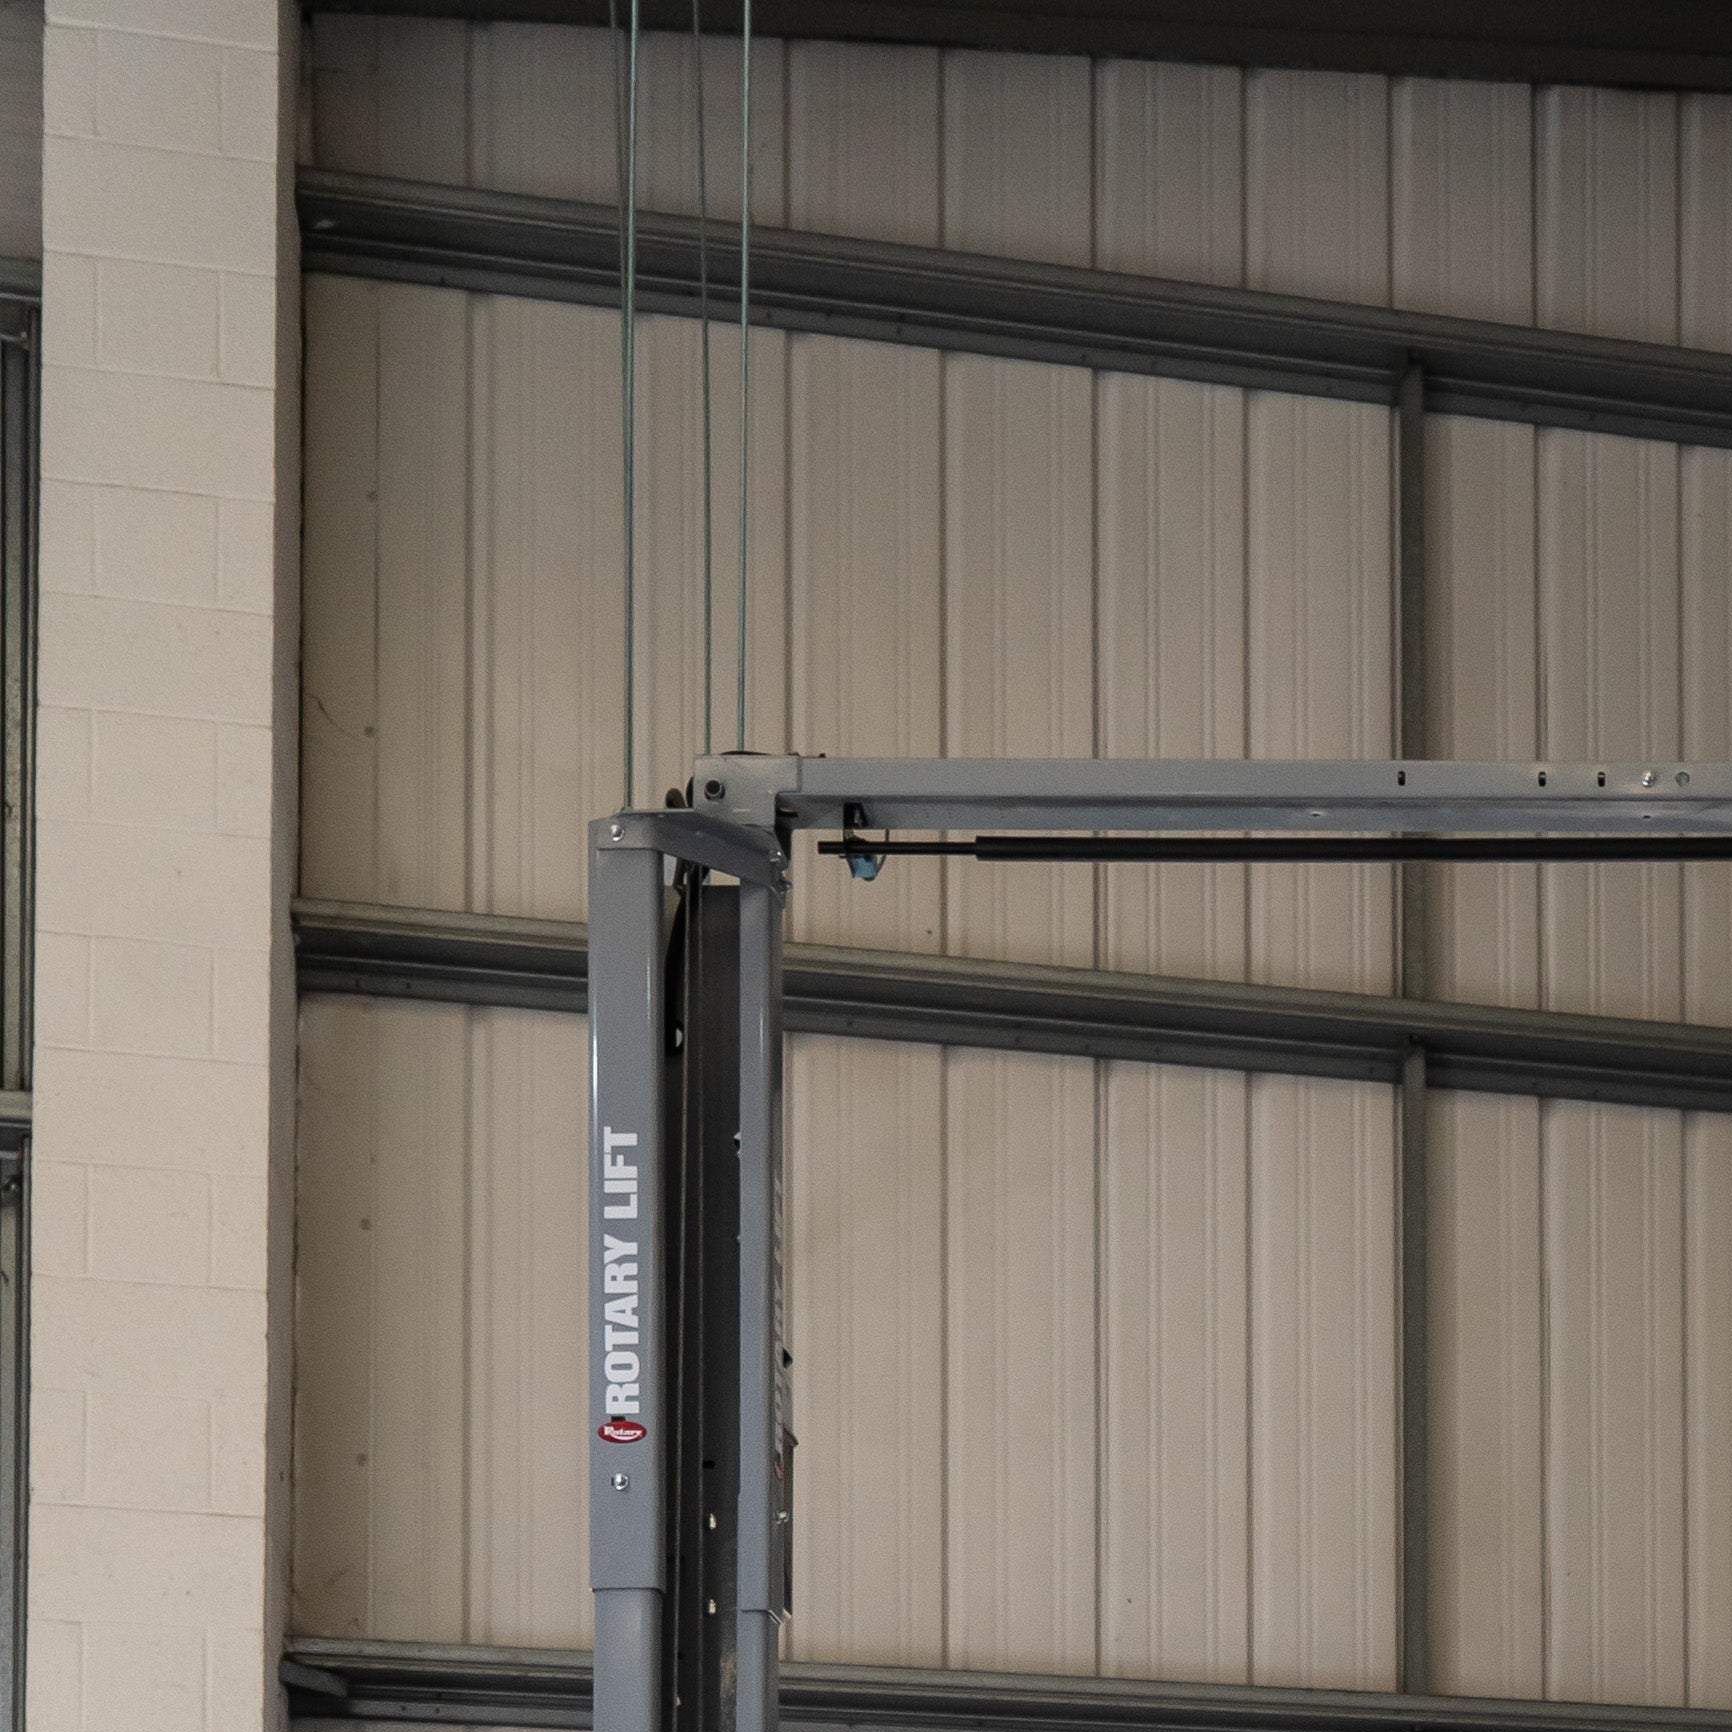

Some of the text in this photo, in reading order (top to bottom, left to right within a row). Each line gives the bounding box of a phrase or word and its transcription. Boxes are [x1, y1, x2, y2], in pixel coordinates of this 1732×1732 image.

[603, 1126, 640, 1414] ROTARY LIFT
[603, 1425, 642, 1440] Rotary
